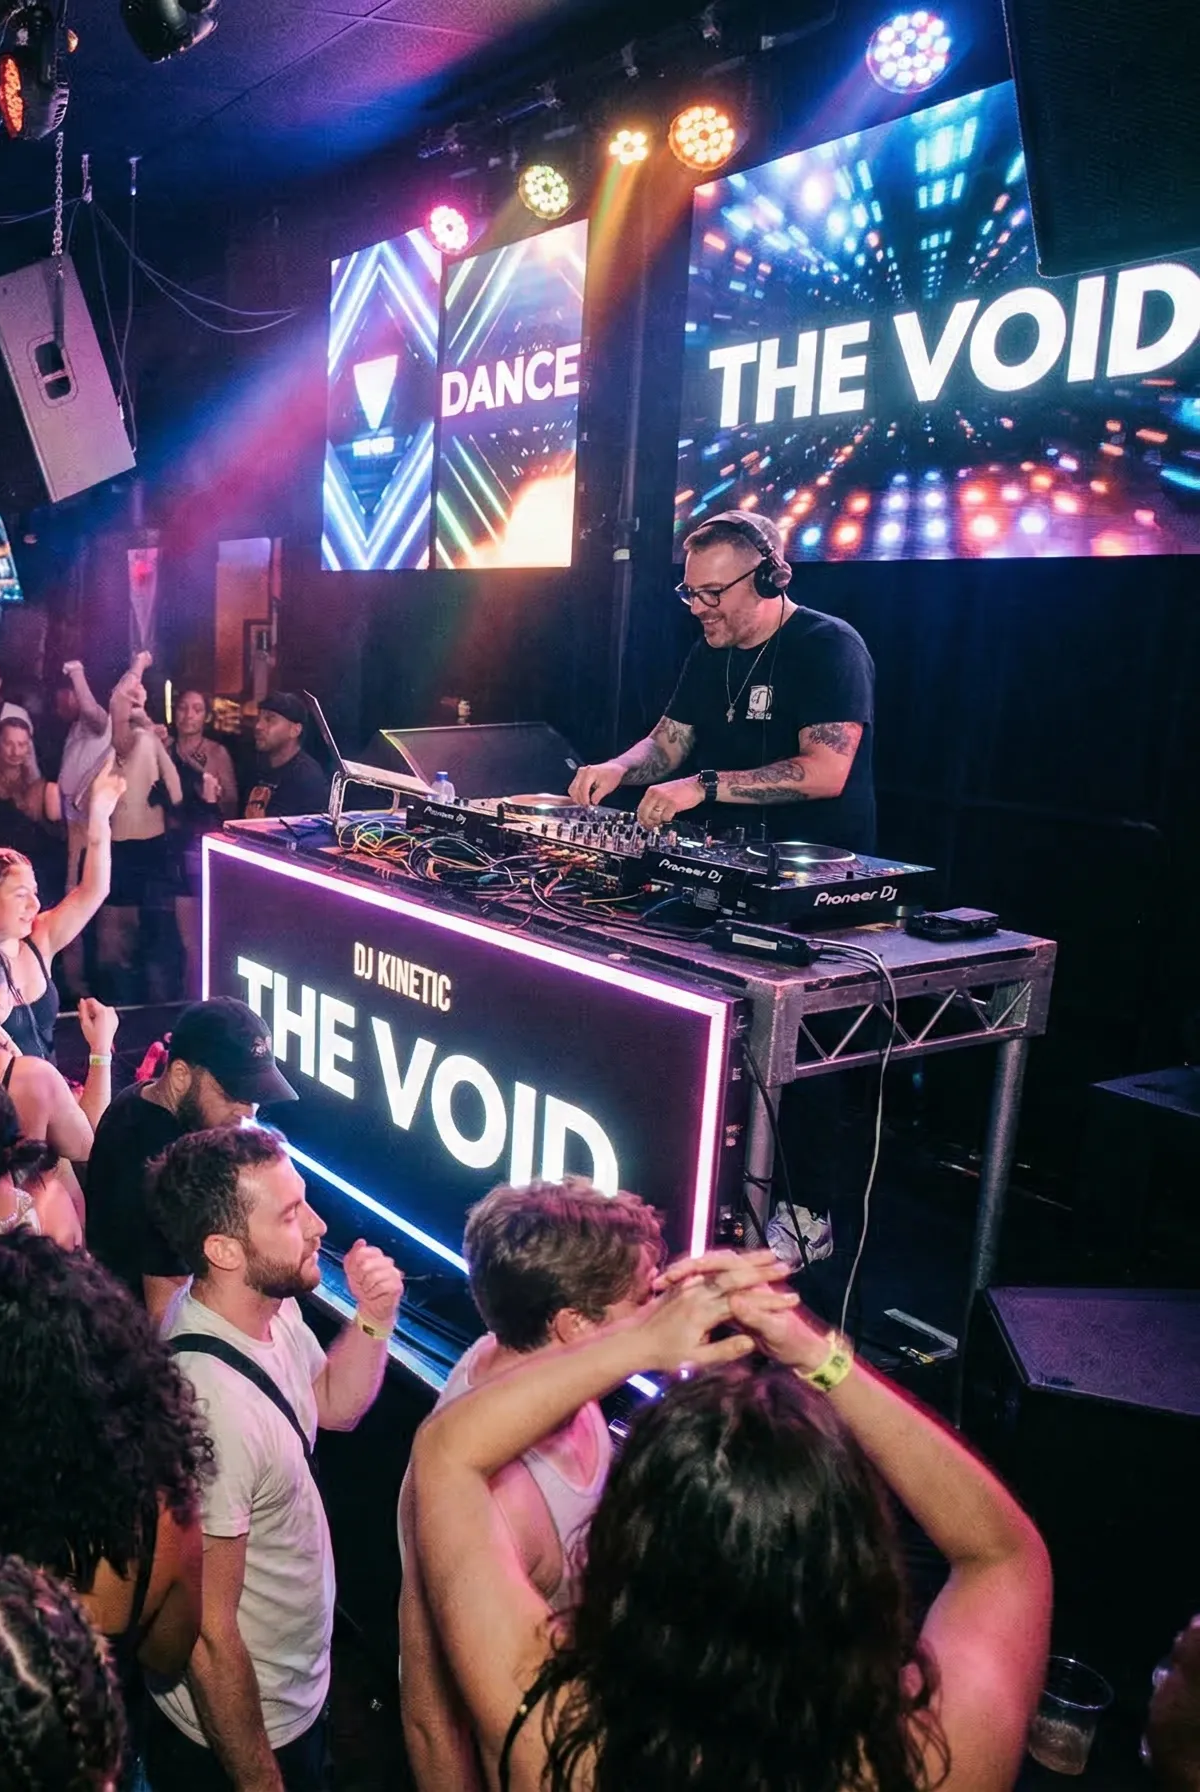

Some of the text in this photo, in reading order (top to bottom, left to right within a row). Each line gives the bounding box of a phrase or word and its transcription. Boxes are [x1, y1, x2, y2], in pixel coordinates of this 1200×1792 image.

[441, 343, 581, 417] DANCE
[709, 262, 1200, 428] THE VOID
[659, 858, 723, 883] Pioneer DJ
[813, 885, 898, 906] Pioneer DJ
[354, 941, 451, 1012] DJ KINETIC
[237, 956, 619, 1198] THE VOID
